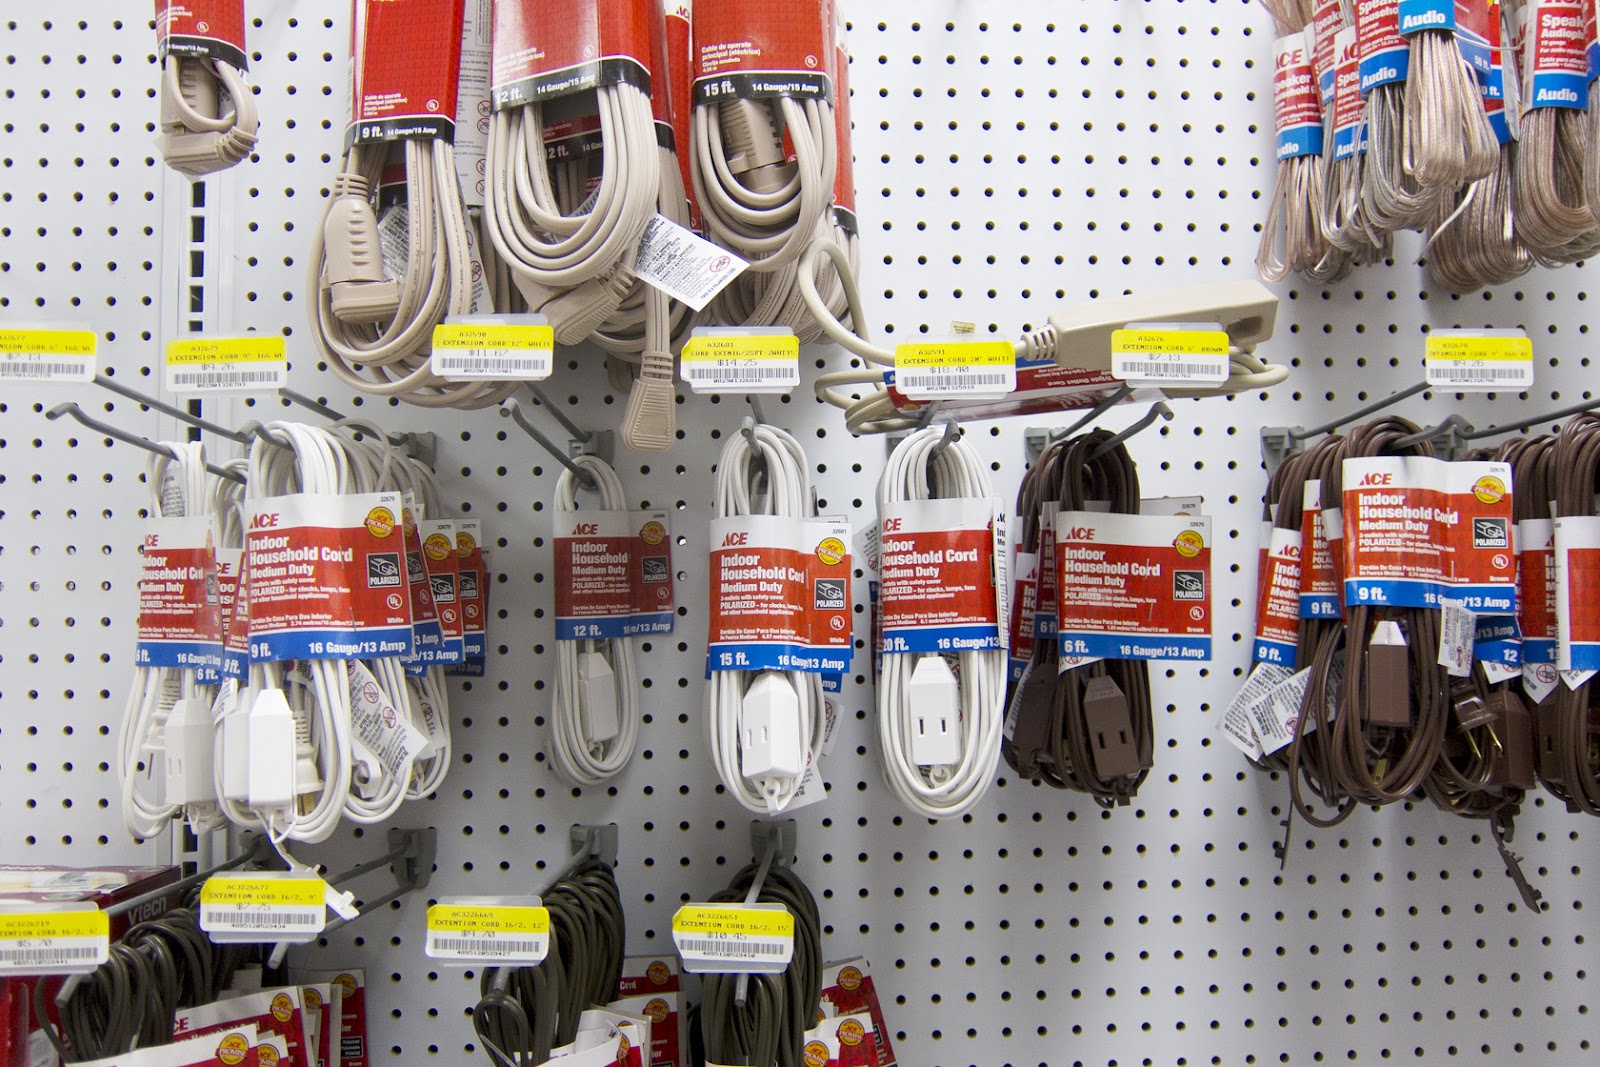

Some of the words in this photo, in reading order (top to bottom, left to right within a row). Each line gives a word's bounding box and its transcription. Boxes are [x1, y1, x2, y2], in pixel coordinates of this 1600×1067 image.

[1403, 11, 1445, 29] Audio
[728, 42, 751, 50] aparato
[1362, 68, 1397, 88] Audio
[511, 88, 522, 99] ft.
[537, 86, 545, 94] 14
[547, 78, 579, 92] Gauge/15
[704, 83, 719, 96] 15
[721, 81, 735, 94] ft.
[764, 83, 799, 92] Gauge/15
[802, 83, 819, 93] Amp
[1489, 86, 1499, 96] ft.
[1537, 88, 1577, 101] Audio
[362, 127, 369, 138] 9
[372, 126, 383, 137] ft.
[557, 145, 569, 156] ft.
[1360, 473, 1392, 486] ACE
[1359, 493, 1405, 505] Indoor
[1360, 507, 1432, 520] Household
[250, 513, 279, 528] ACE
[1360, 521, 1403, 530] Medium
[1406, 522, 1428, 533] Duty
[572, 523, 598, 535] ACE
[1066, 527, 1095, 540] ACE
[249, 536, 289, 550] Indoor
[722, 533, 748, 546] ACE
[572, 542, 608, 552] Indoor
[250, 547, 318, 565] Household
[322, 547, 353, 562] Cord
[572, 553, 628, 564] Household
[946, 549, 978, 562] Cord
[1066, 548, 1105, 560] Indoor
[721, 555, 760, 567] Indoor
[250, 566, 286, 579] Medium
[288, 564, 314, 576] Duty
[608, 566, 625, 575] Duty
[916, 566, 939, 578] Duty
[1066, 560, 1129, 574] Household
[1131, 564, 1160, 576] Cord
[370, 577, 399, 585] POLARIZED
[721, 567, 786, 580] Household
[788, 568, 804, 583] Cord
[1066, 575, 1102, 585] Medium
[1104, 576, 1125, 587] Duty
[166, 582, 184, 593] Duty
[251, 586, 284, 596] POLARIZED
[721, 583, 757, 593] Medium
[760, 582, 782, 594] Duty
[1359, 588, 1368, 600] 9
[1370, 588, 1386, 600] ft.
[1425, 593, 1436, 603] 16
[1484, 598, 1510, 608] Amp
[721, 601, 755, 609] POLARIZED
[1311, 603, 1319, 614] 9
[1322, 603, 1335, 614] ft.
[573, 626, 586, 636] 12
[589, 625, 601, 635] ft.
[652, 623, 670, 632] Amp
[251, 645, 258, 658] 9
[260, 643, 271, 656] ft.
[309, 643, 323, 653] 16
[326, 642, 377, 655] Gauge/13
[379, 641, 406, 652] Amp
[894, 638, 909, 651] ft.
[938, 638, 950, 648] 16
[953, 637, 999, 649] Gauge/13
[1064, 641, 1072, 653] 6
[1074, 641, 1089, 653] ft.
[1120, 646, 1131, 655] 16
[1133, 646, 1179, 657] Gauge/13
[1182, 647, 1204, 658] Amp
[141, 650, 149, 662] ft.
[177, 654, 186, 663] 16
[436, 650, 458, 661] Amp
[1259, 647, 1267, 658] 9
[1269, 648, 1281, 661] ft.
[1504, 649, 1517, 662] 12
[224, 659, 230, 672] 9
[231, 660, 240, 673] ft.
[720, 653, 732, 665] 15
[735, 652, 749, 665] ft.
[778, 656, 789, 665] 16
[821, 659, 845, 671] Amp
[198, 670, 203, 679] 6
[205, 669, 218, 679] ft.
[707, 932, 747, 940] $10.45
[219, 1049, 245, 1057] PROMISE
